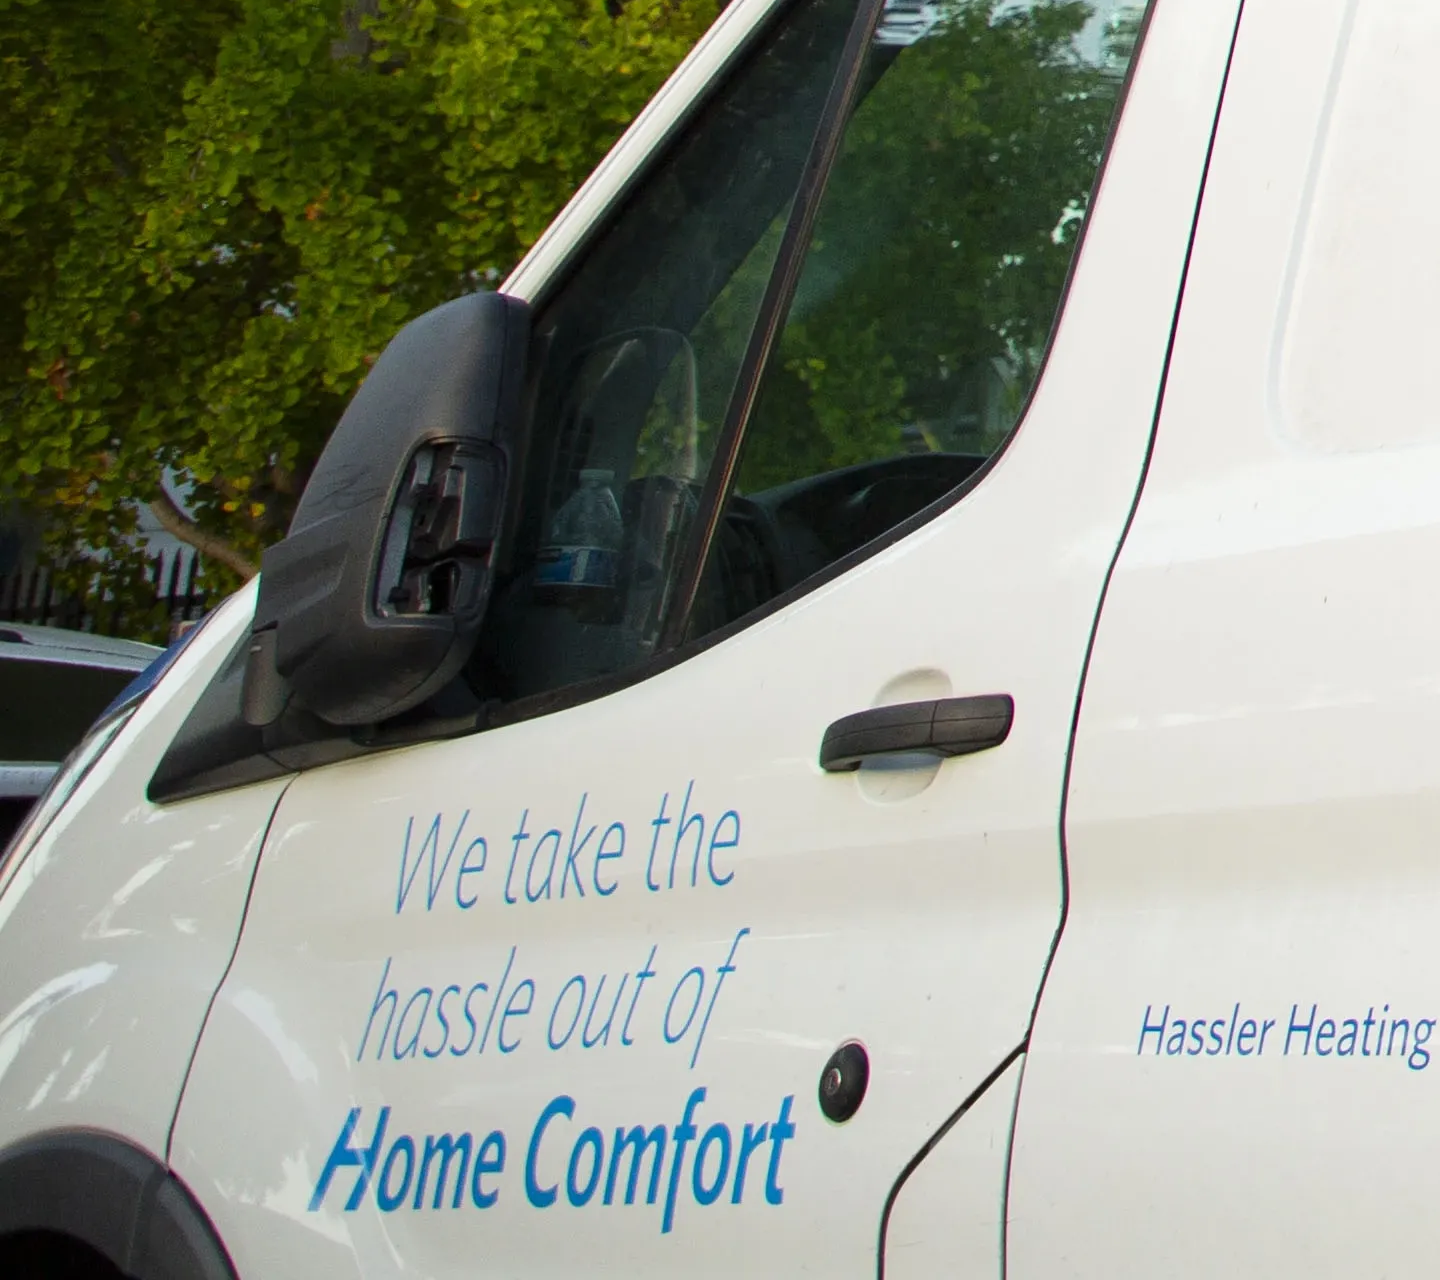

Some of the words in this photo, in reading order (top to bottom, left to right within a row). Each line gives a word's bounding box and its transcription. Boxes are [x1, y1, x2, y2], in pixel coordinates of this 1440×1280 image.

[396, 810, 488, 915] We
[503, 792, 626, 906] take
[645, 780, 741, 893] the
[356, 946, 536, 1063] hassle
[547, 946, 658, 1052] out
[663, 927, 751, 1070] of
[1137, 1002, 1276, 1057] Hassler
[1283, 1000, 1437, 1072] Heating
[307, 1105, 507, 1216] Home
[522, 1086, 797, 1236] Comfort
